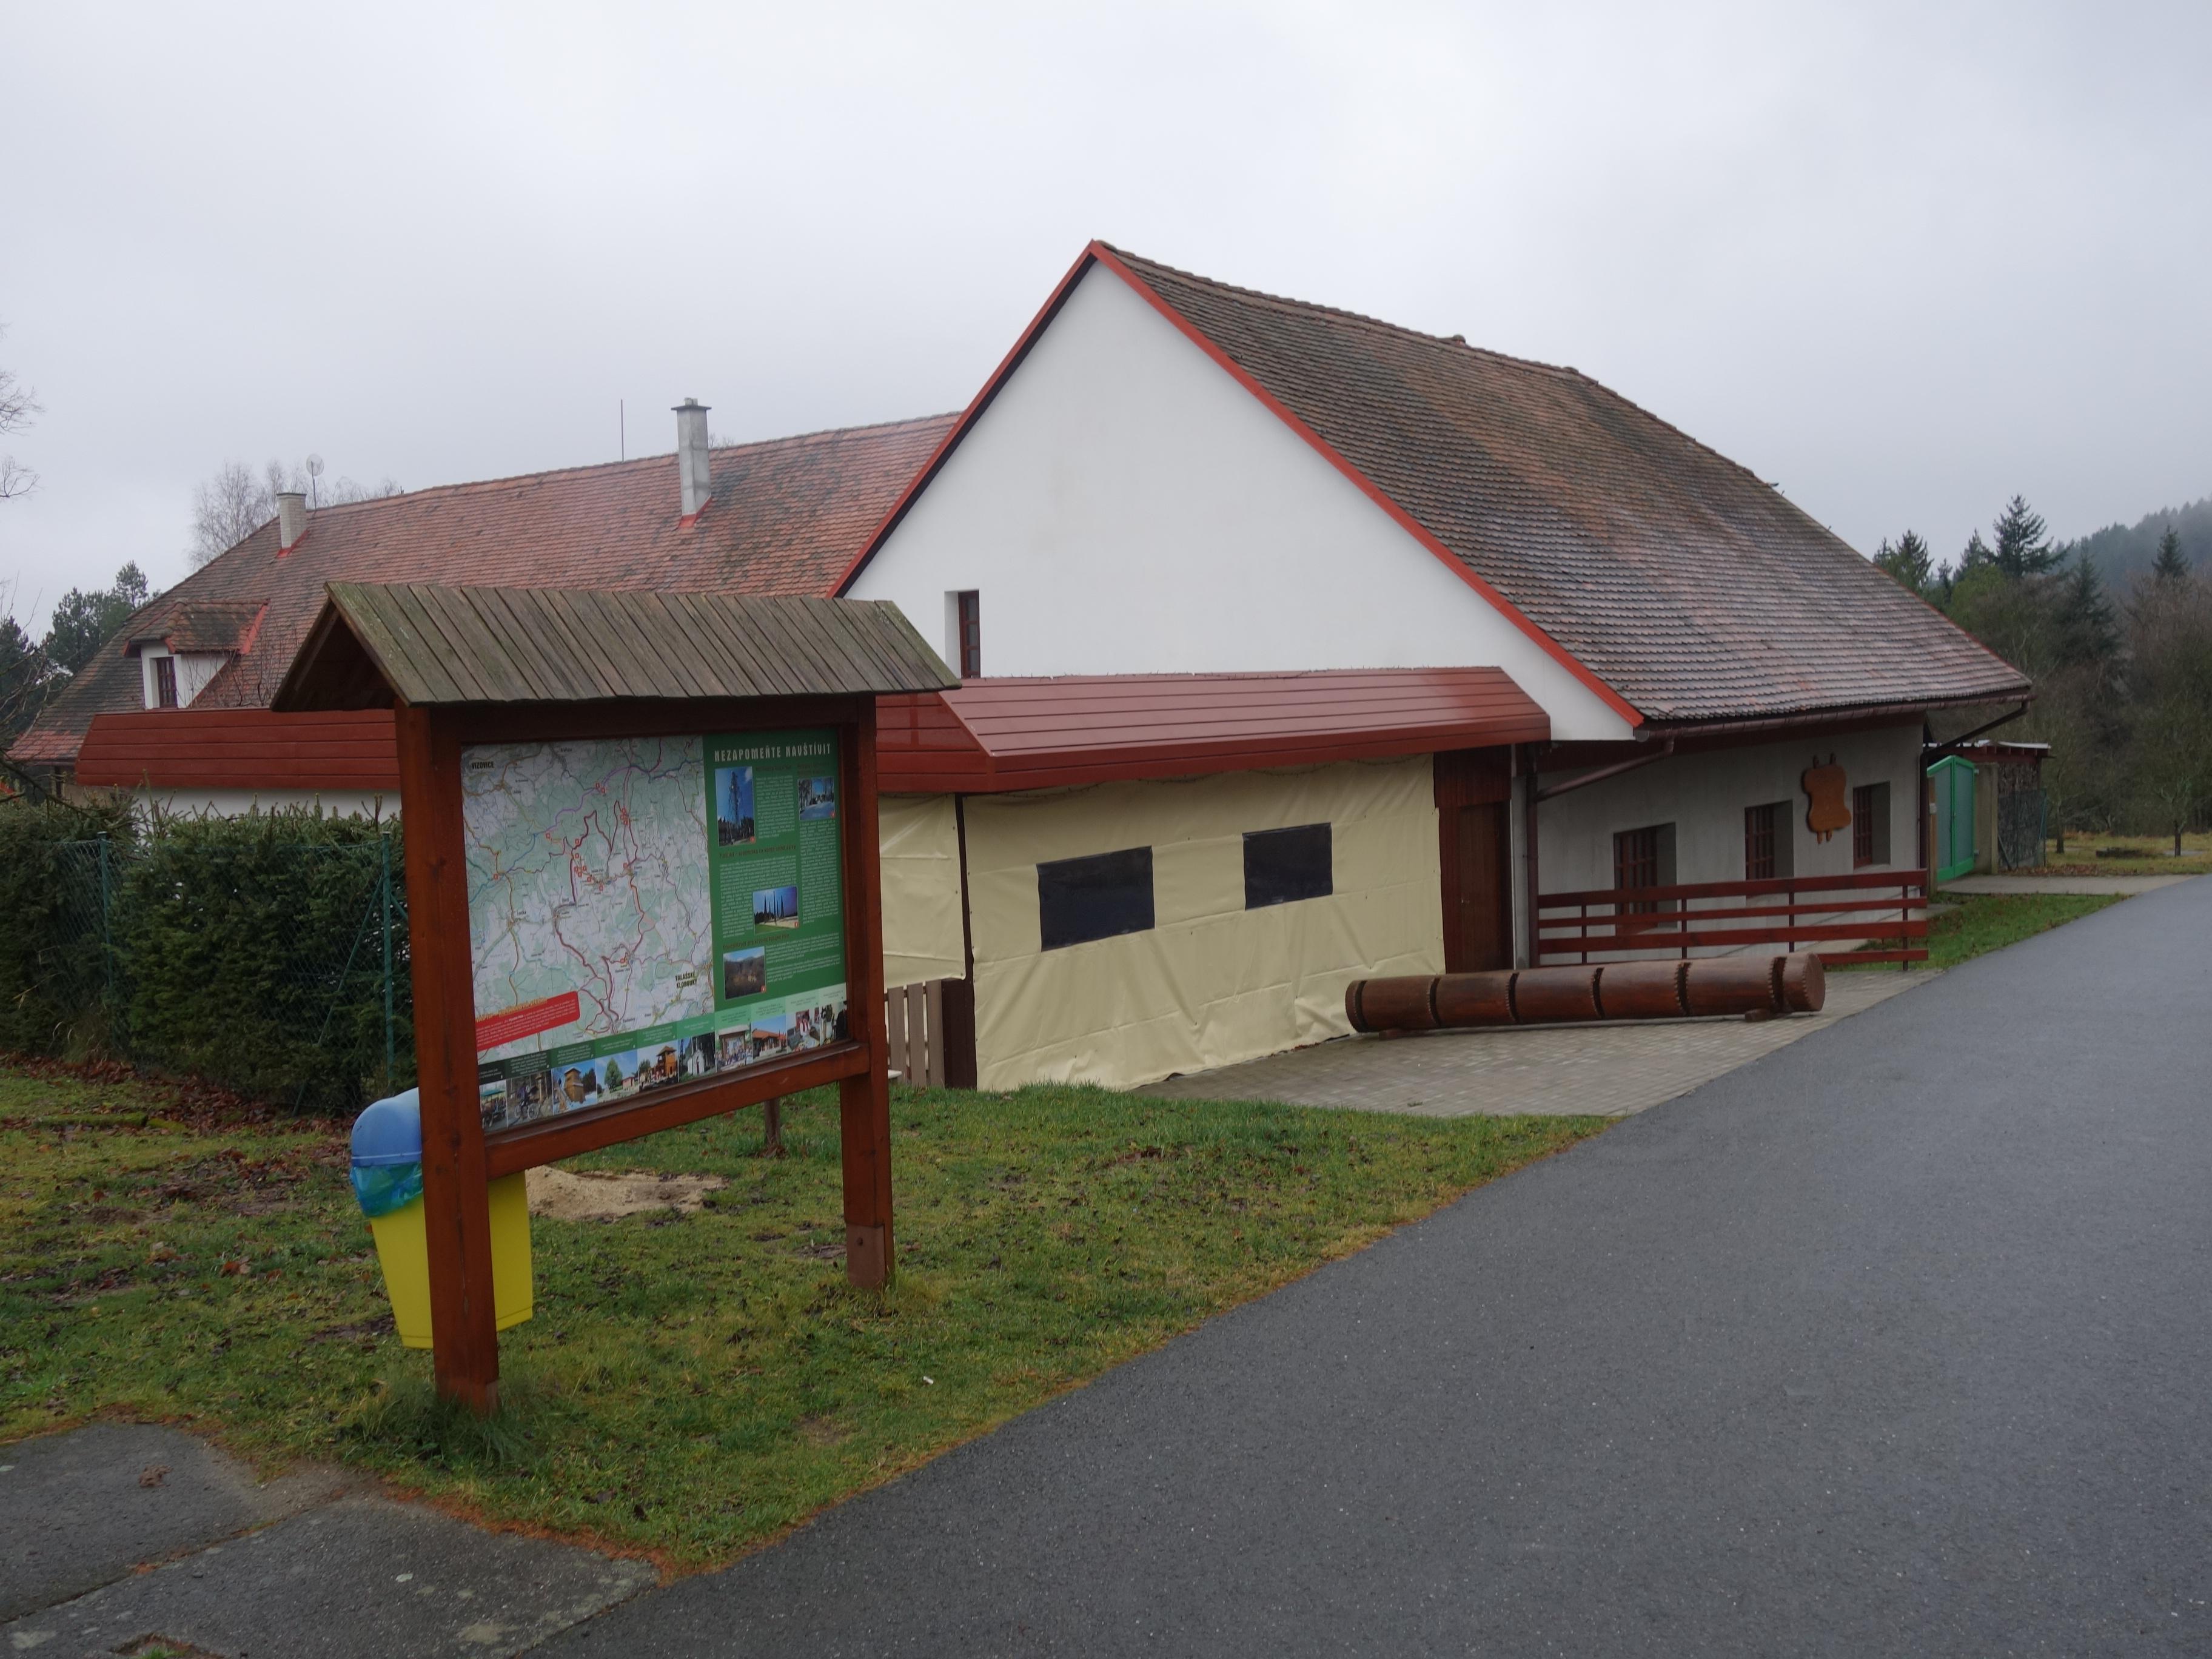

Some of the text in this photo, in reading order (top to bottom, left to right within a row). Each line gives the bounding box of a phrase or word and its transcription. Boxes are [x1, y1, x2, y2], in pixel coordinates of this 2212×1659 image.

[714, 742, 830, 762] NEZAPOMEŇTE NAVŠTÍVIT
[675, 971, 695, 981] VALAŠSKÉ
[676, 979, 697, 988] KLOBOUKY
